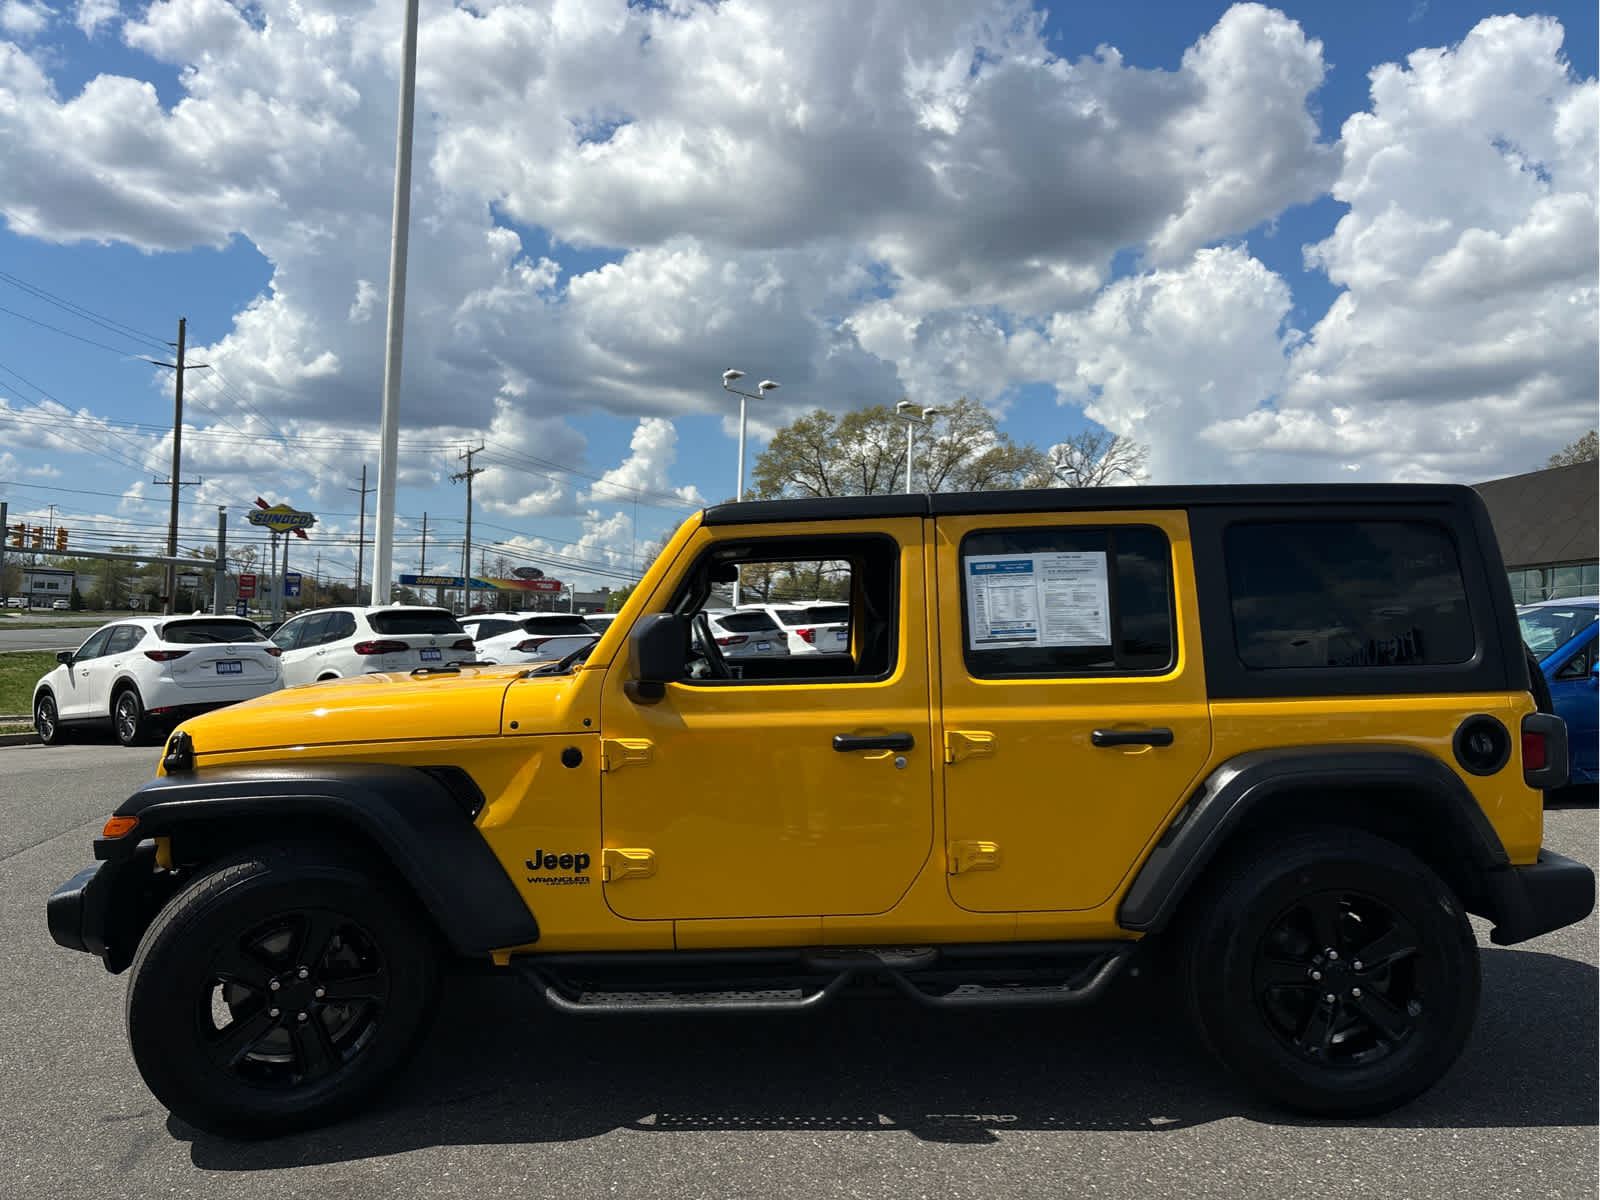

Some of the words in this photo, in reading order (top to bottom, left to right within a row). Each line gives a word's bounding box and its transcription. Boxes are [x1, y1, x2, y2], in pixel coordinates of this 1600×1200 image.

[253, 512, 310, 525] SUNOCO
[415, 576, 455, 585] SUNOCO
[525, 849, 590, 873] Jeep
[526, 876, 590, 884] WRANGLER
